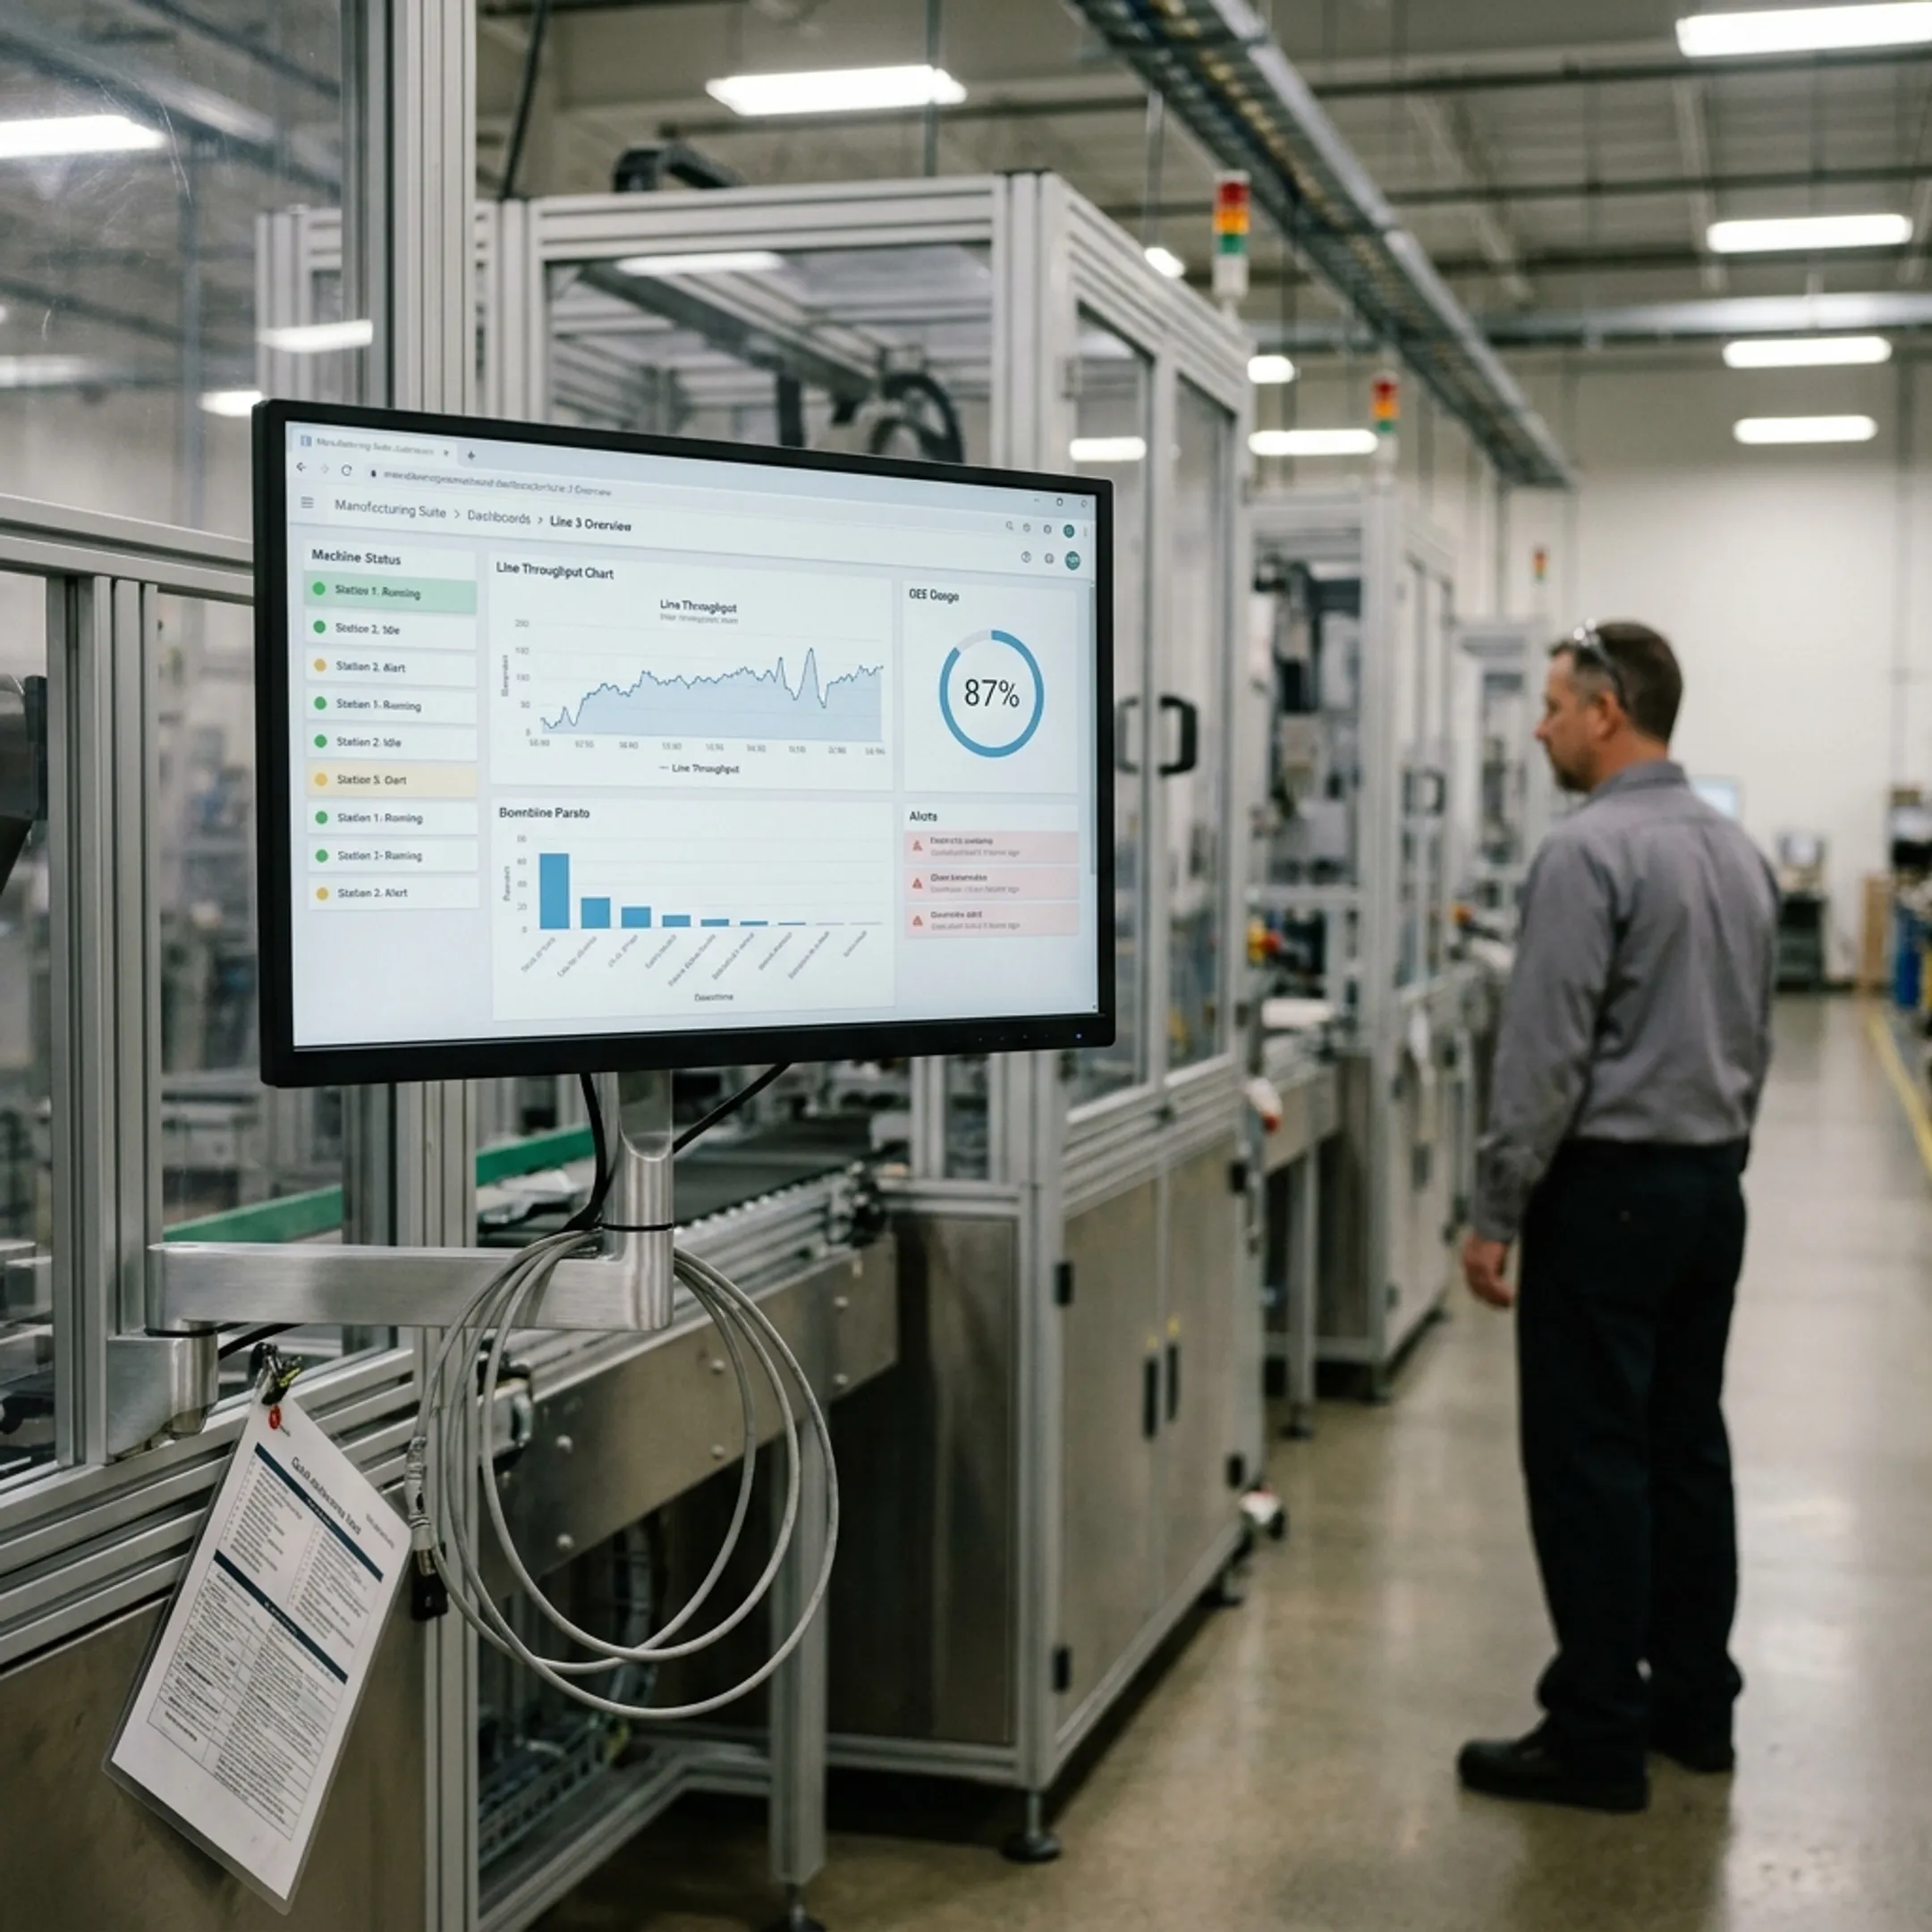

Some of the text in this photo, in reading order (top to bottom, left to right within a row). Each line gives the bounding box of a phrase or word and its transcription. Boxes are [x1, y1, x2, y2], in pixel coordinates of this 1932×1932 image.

[419, 505, 446, 518] Suite
[576, 517, 582, 529] 3
[585, 567, 614, 580] Chart
[965, 679, 1020, 708] 87%
